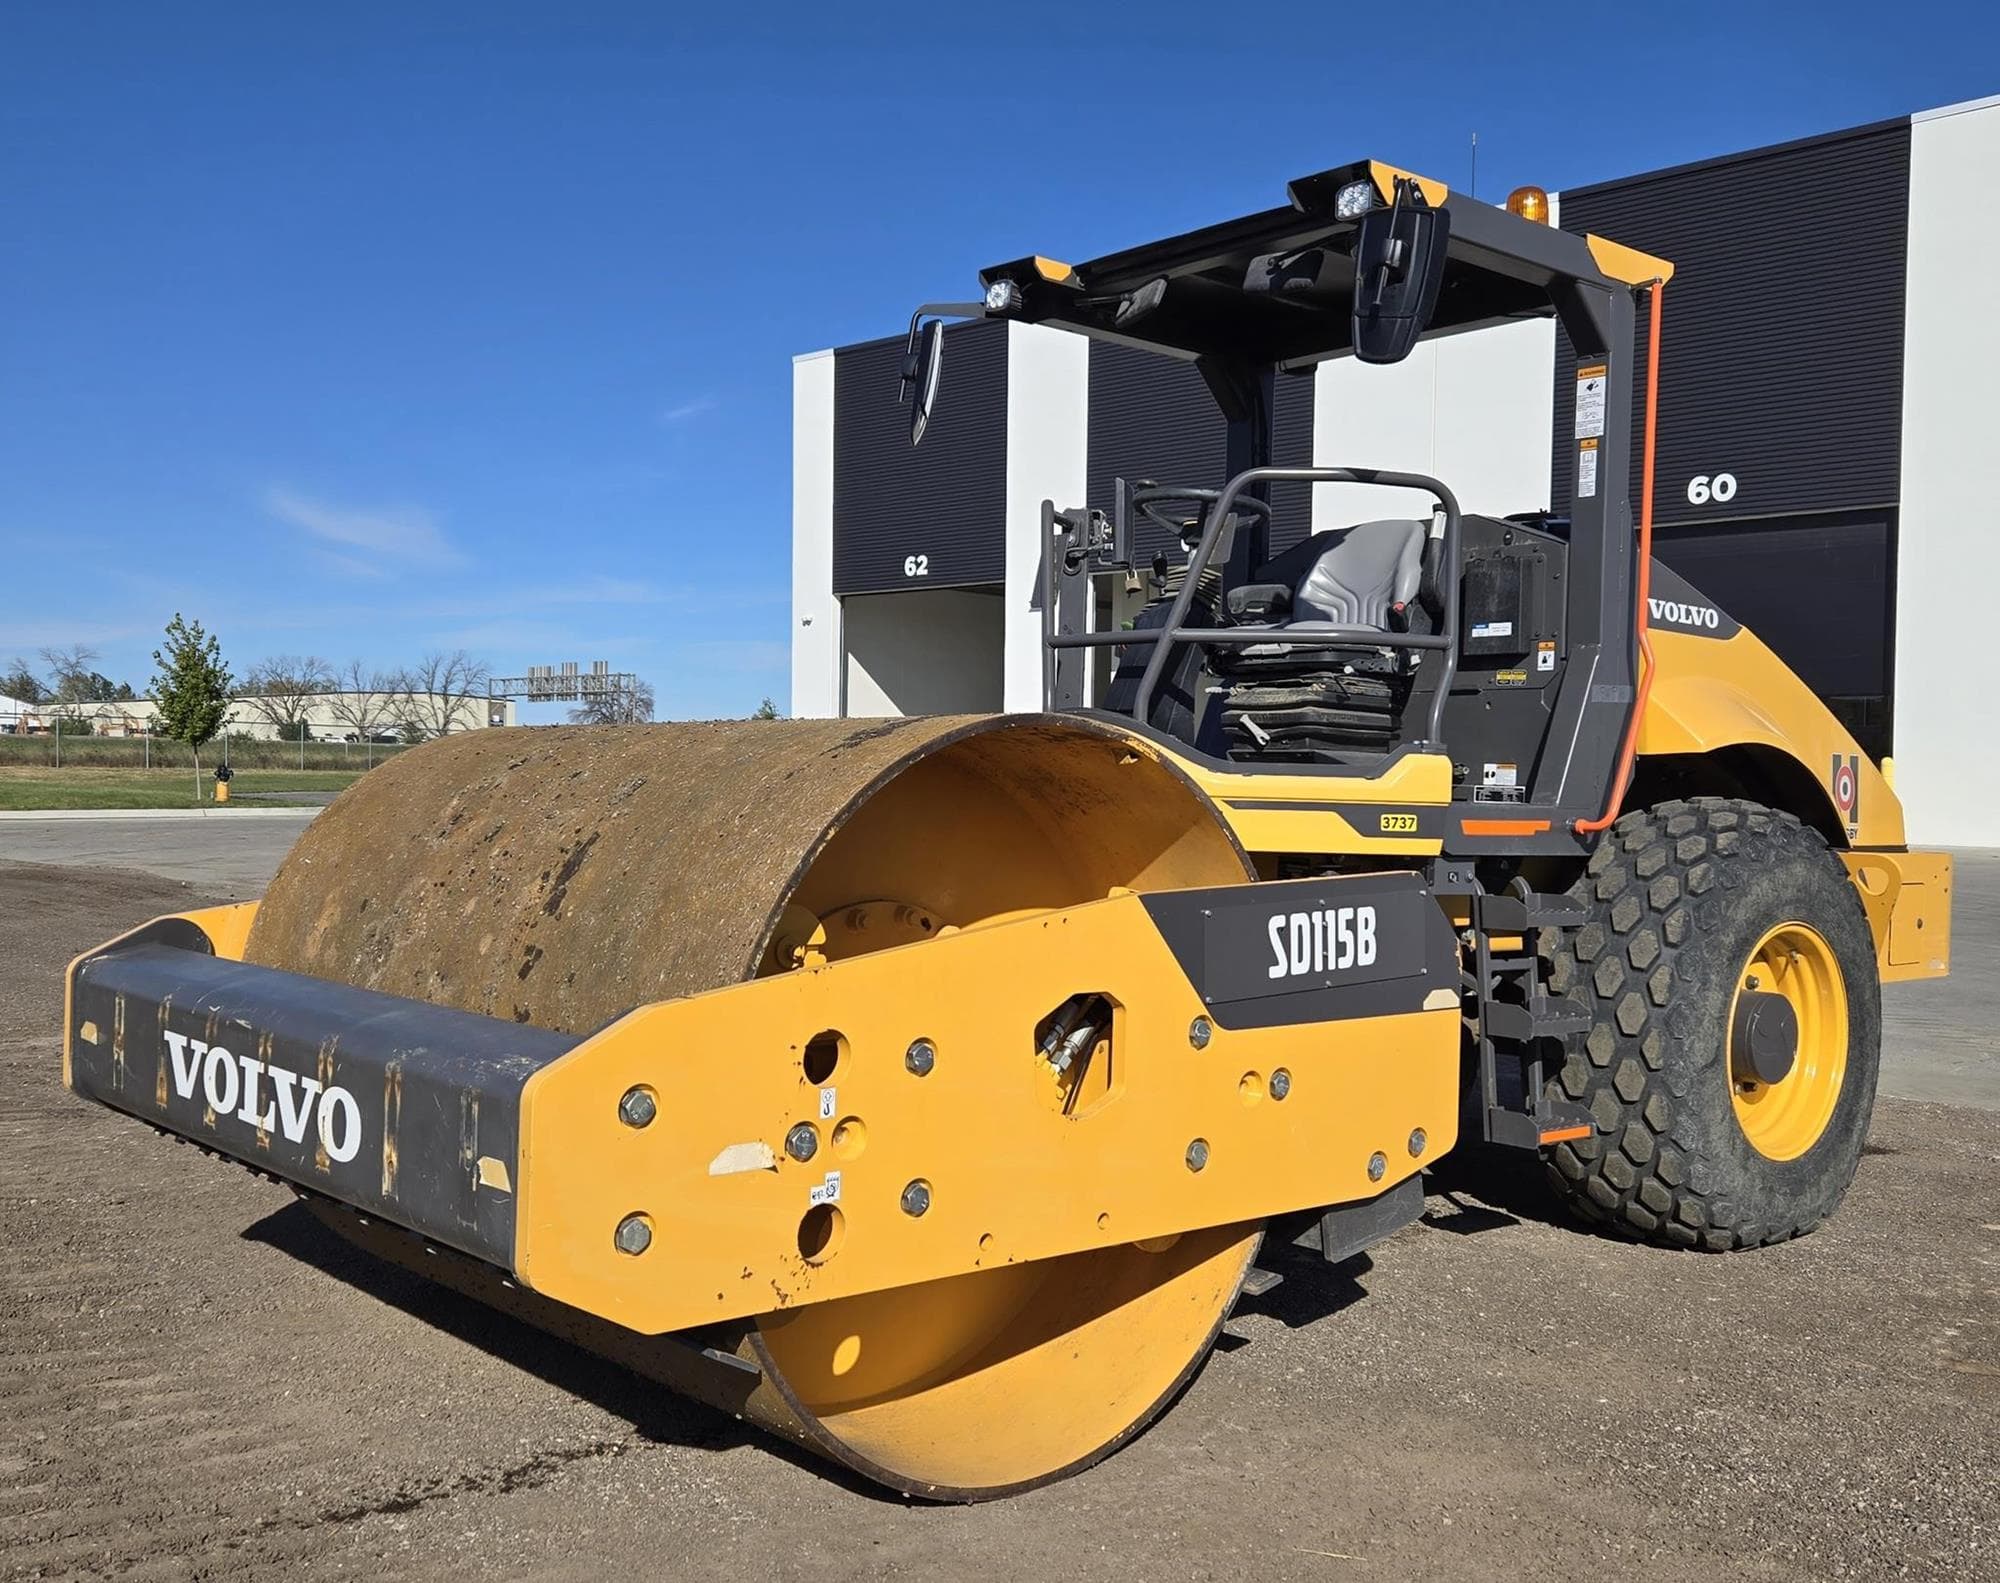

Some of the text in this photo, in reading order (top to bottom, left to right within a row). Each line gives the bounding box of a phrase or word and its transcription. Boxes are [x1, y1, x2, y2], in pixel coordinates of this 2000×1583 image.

[1687, 473, 1737, 504] 60
[904, 555, 928, 576] 62
[1647, 598, 1719, 629] VOLVO
[1383, 817, 1415, 829] 3737
[1268, 906, 1377, 979] SD115B
[164, 1030, 361, 1163] VOLVO
